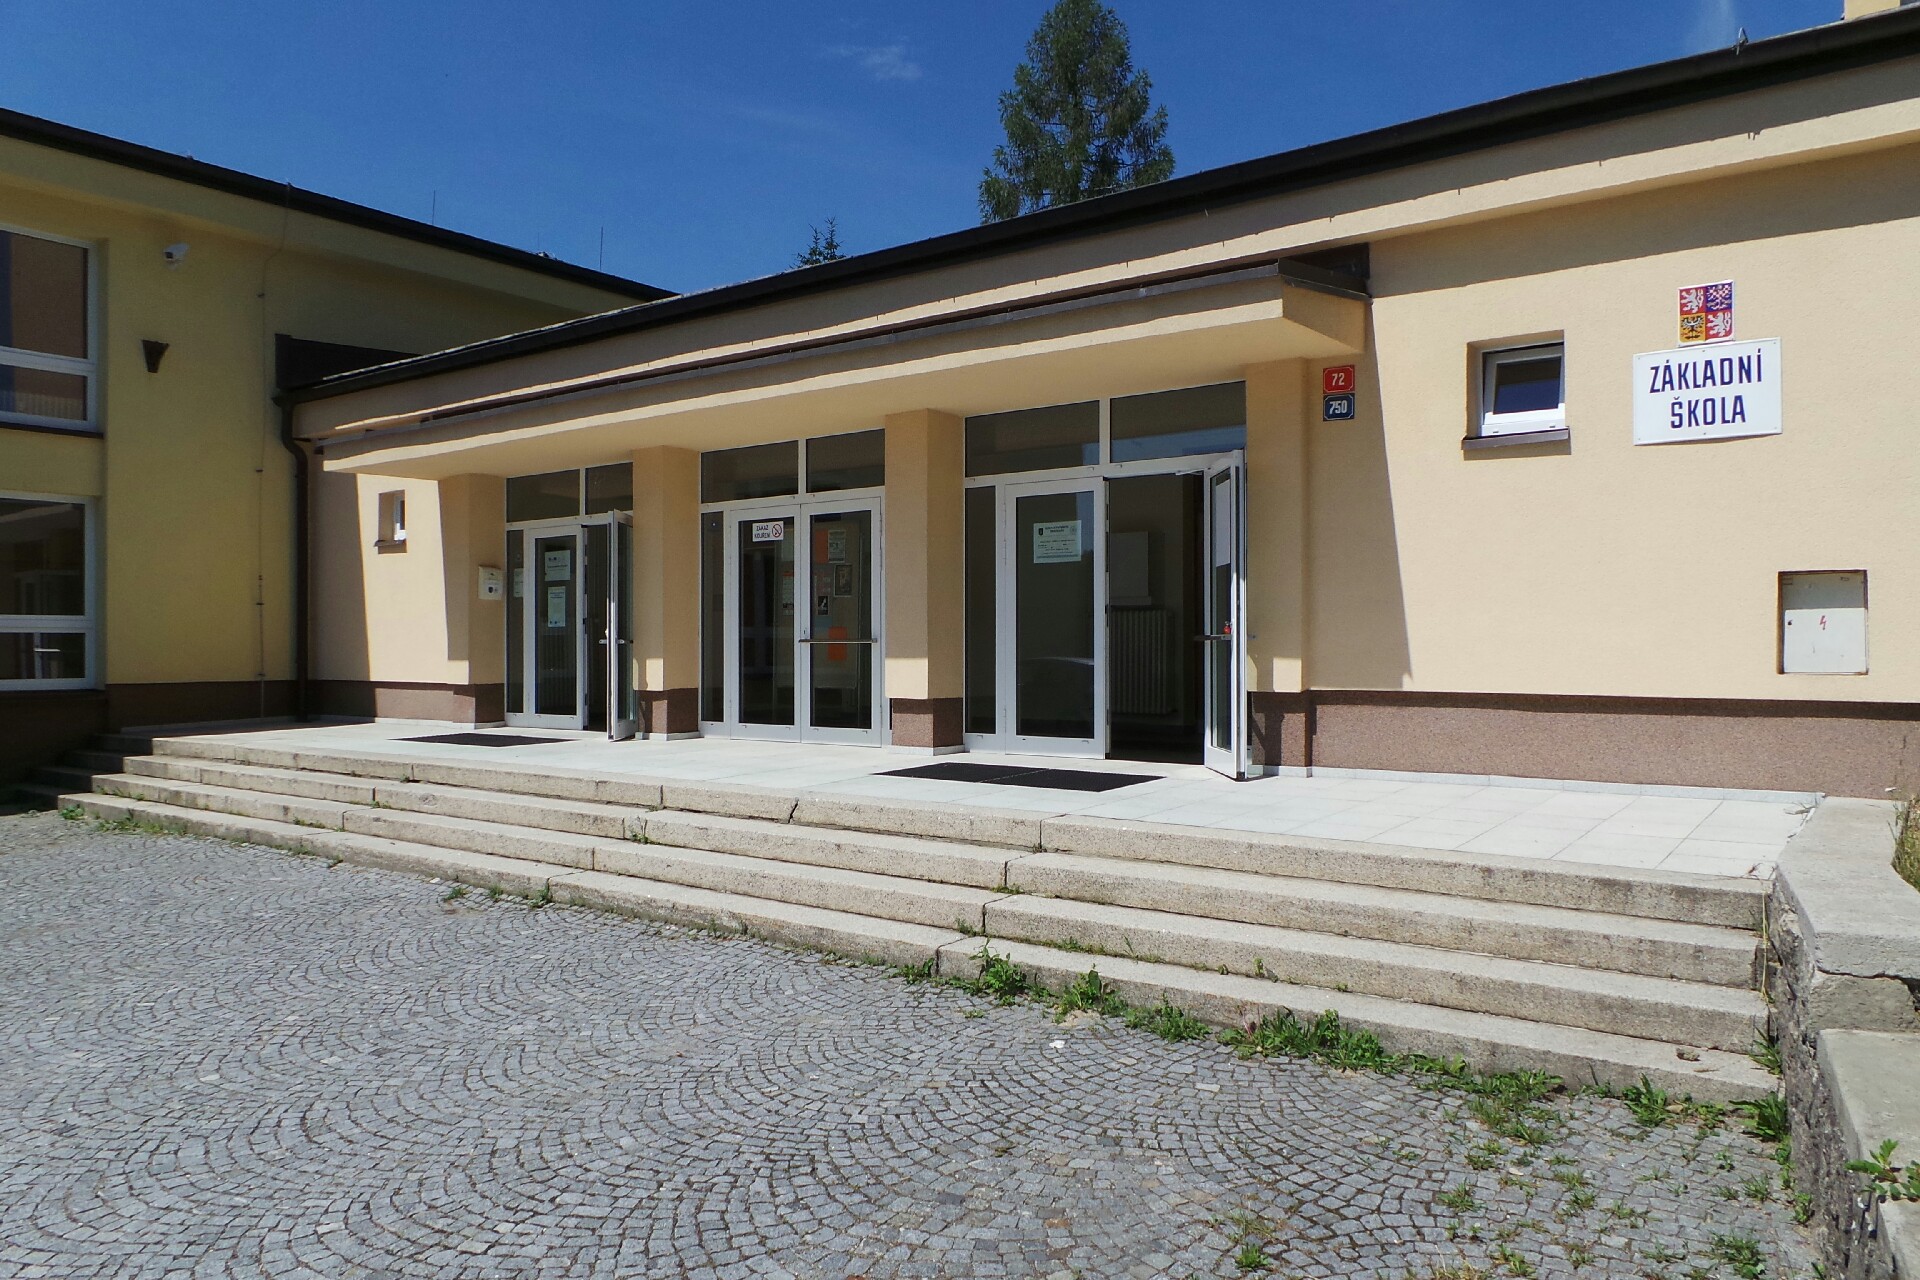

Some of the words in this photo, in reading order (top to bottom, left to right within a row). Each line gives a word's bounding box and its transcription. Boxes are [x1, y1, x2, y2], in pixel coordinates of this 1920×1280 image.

[1332, 372, 1345, 386] 72
[1649, 348, 1762, 393] ZÁKLADNÍ
[1329, 399, 1348, 415] 750
[1670, 395, 1746, 429] ŠKOLA
